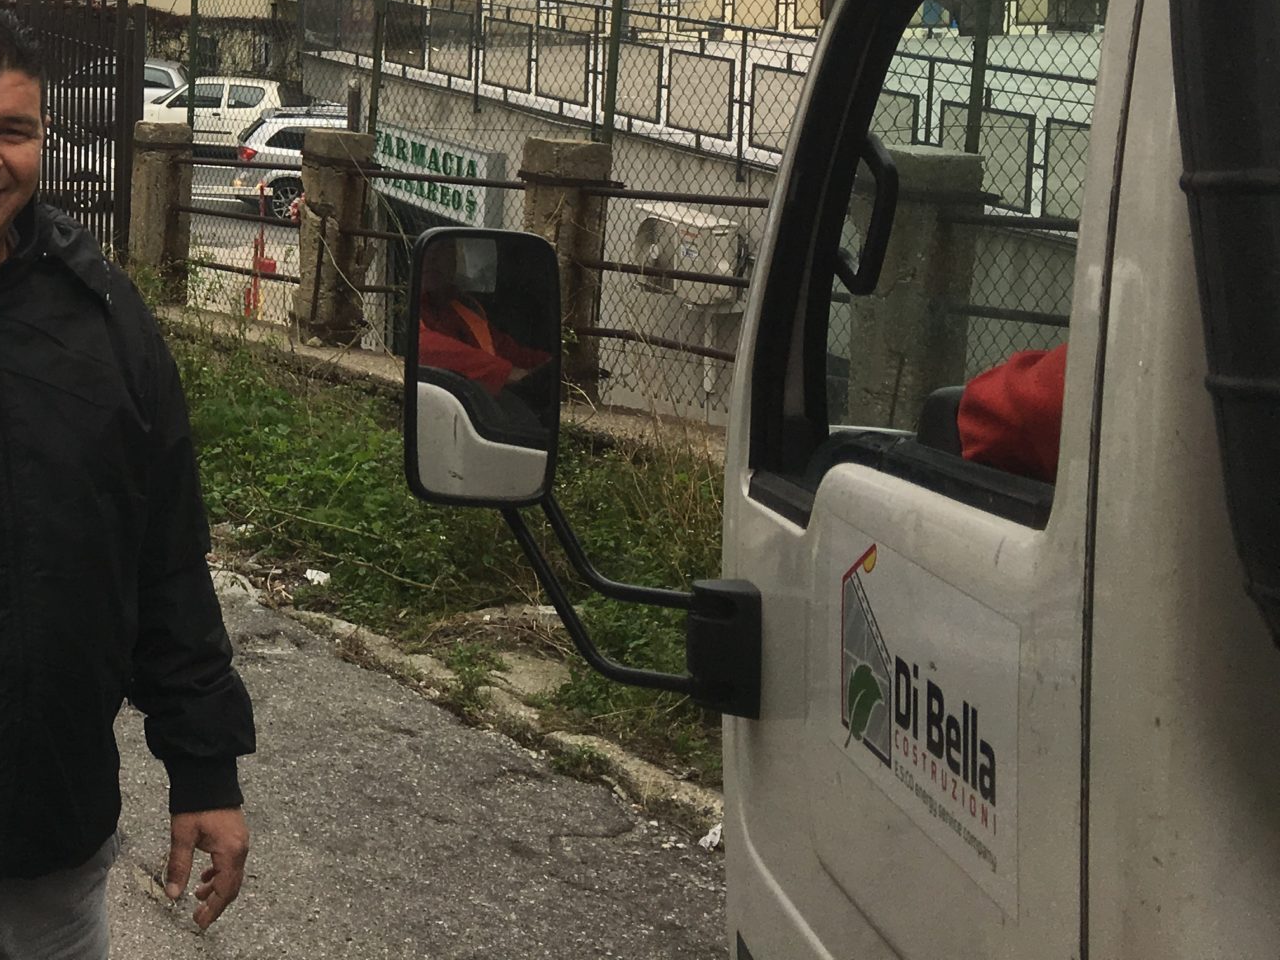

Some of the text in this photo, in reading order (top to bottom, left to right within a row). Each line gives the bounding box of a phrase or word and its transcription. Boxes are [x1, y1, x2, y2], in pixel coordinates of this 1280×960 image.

[894, 655, 997, 808] Di Bella
[894, 729, 997, 836] COSTRUZIONI
